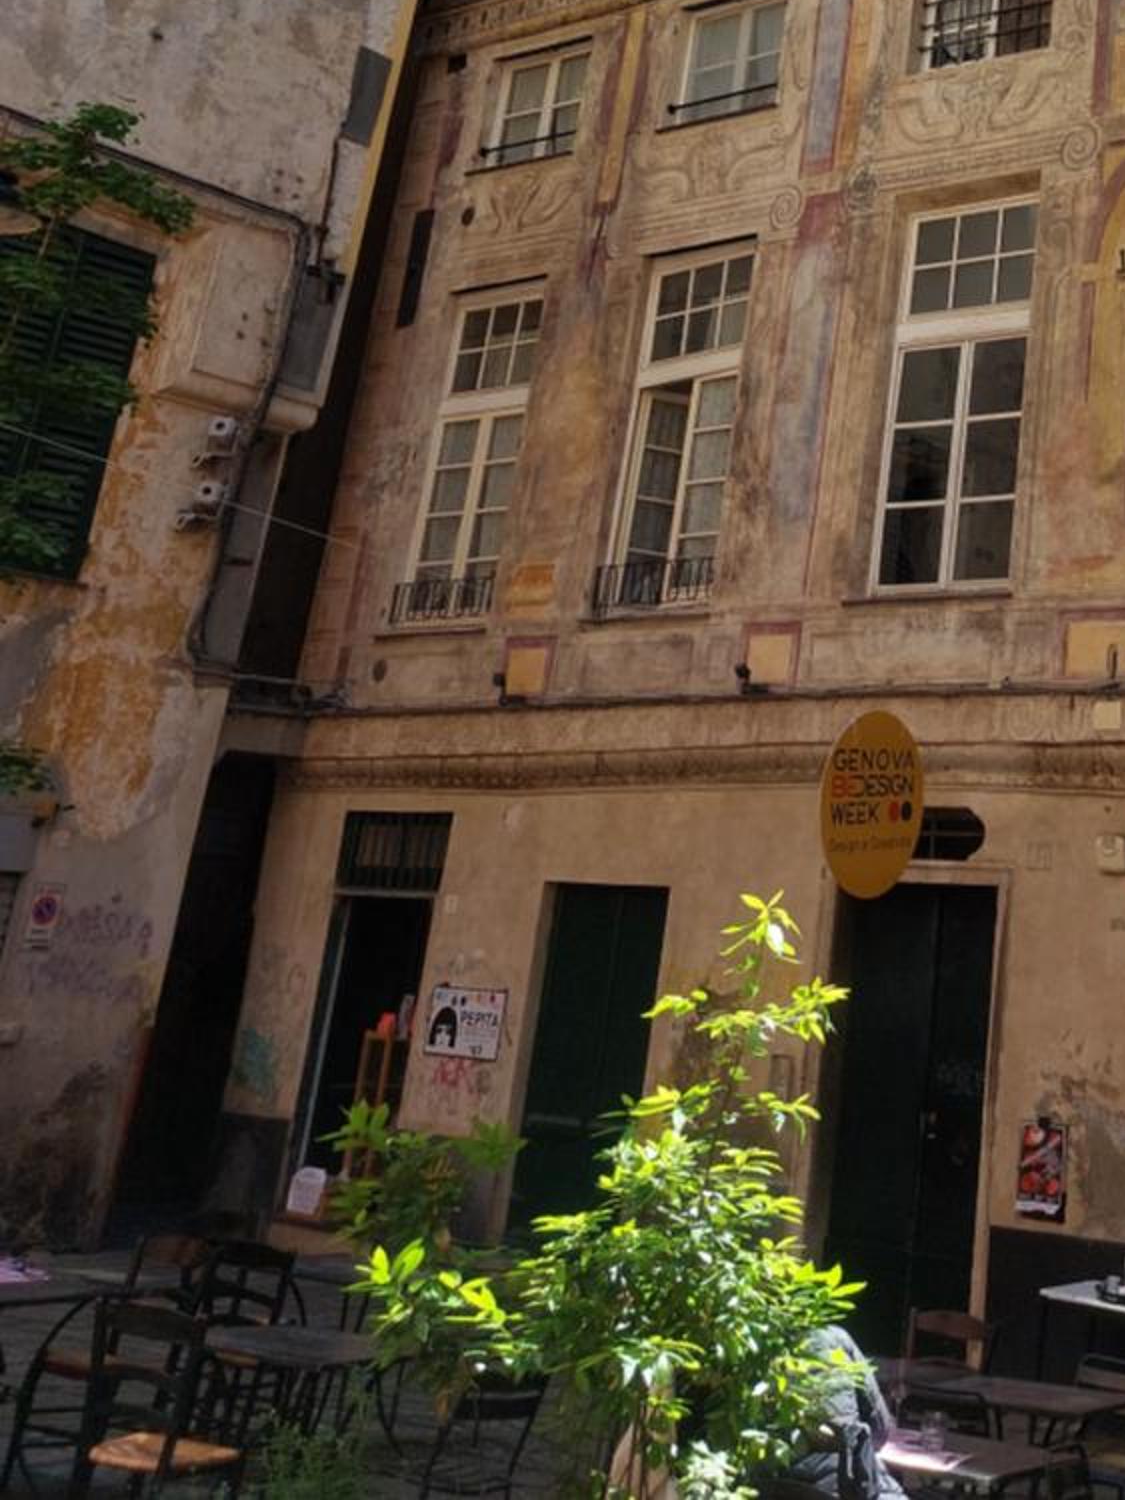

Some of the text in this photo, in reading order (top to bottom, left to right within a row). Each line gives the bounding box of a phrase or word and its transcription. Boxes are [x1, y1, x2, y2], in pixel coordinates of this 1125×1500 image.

[833, 748, 915, 772] GENOVA
[831, 803, 880, 827] WEEK
[460, 1011, 498, 1028] PEPITA
